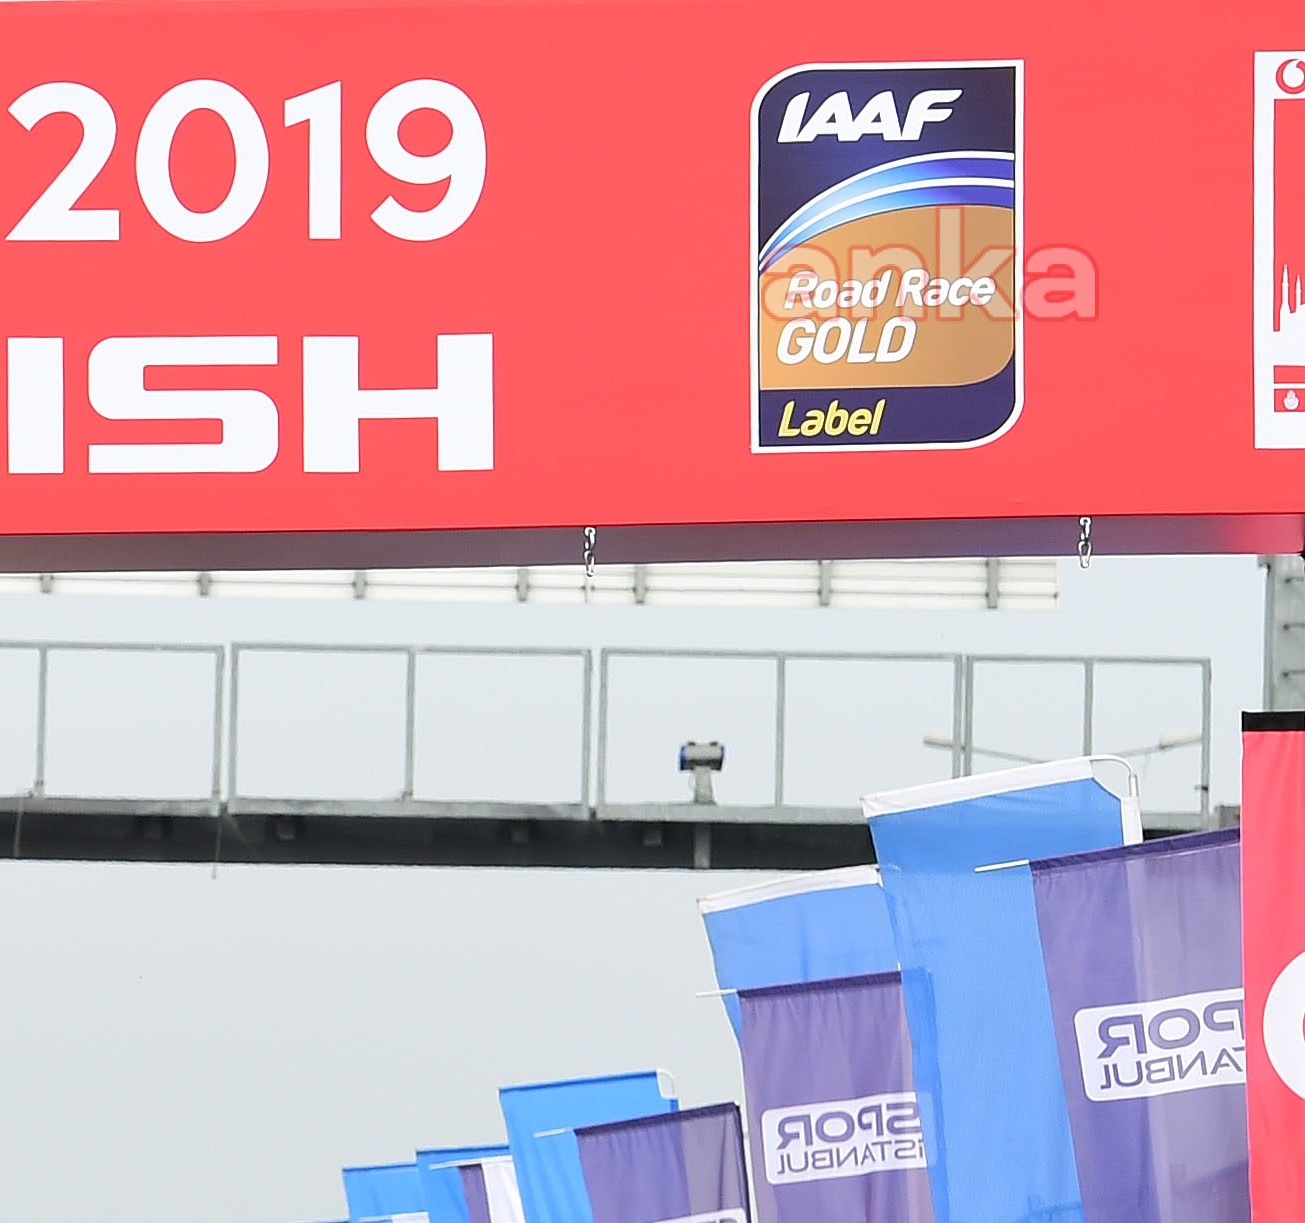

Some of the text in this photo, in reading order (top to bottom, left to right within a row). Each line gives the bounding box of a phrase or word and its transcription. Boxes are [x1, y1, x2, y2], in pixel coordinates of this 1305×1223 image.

[777, 88, 963, 143] IAAF
[5, 77, 488, 243] 2019
[783, 268, 996, 309] Road Race
[777, 316, 917, 365] GOLD
[777, 399, 886, 437] Label
